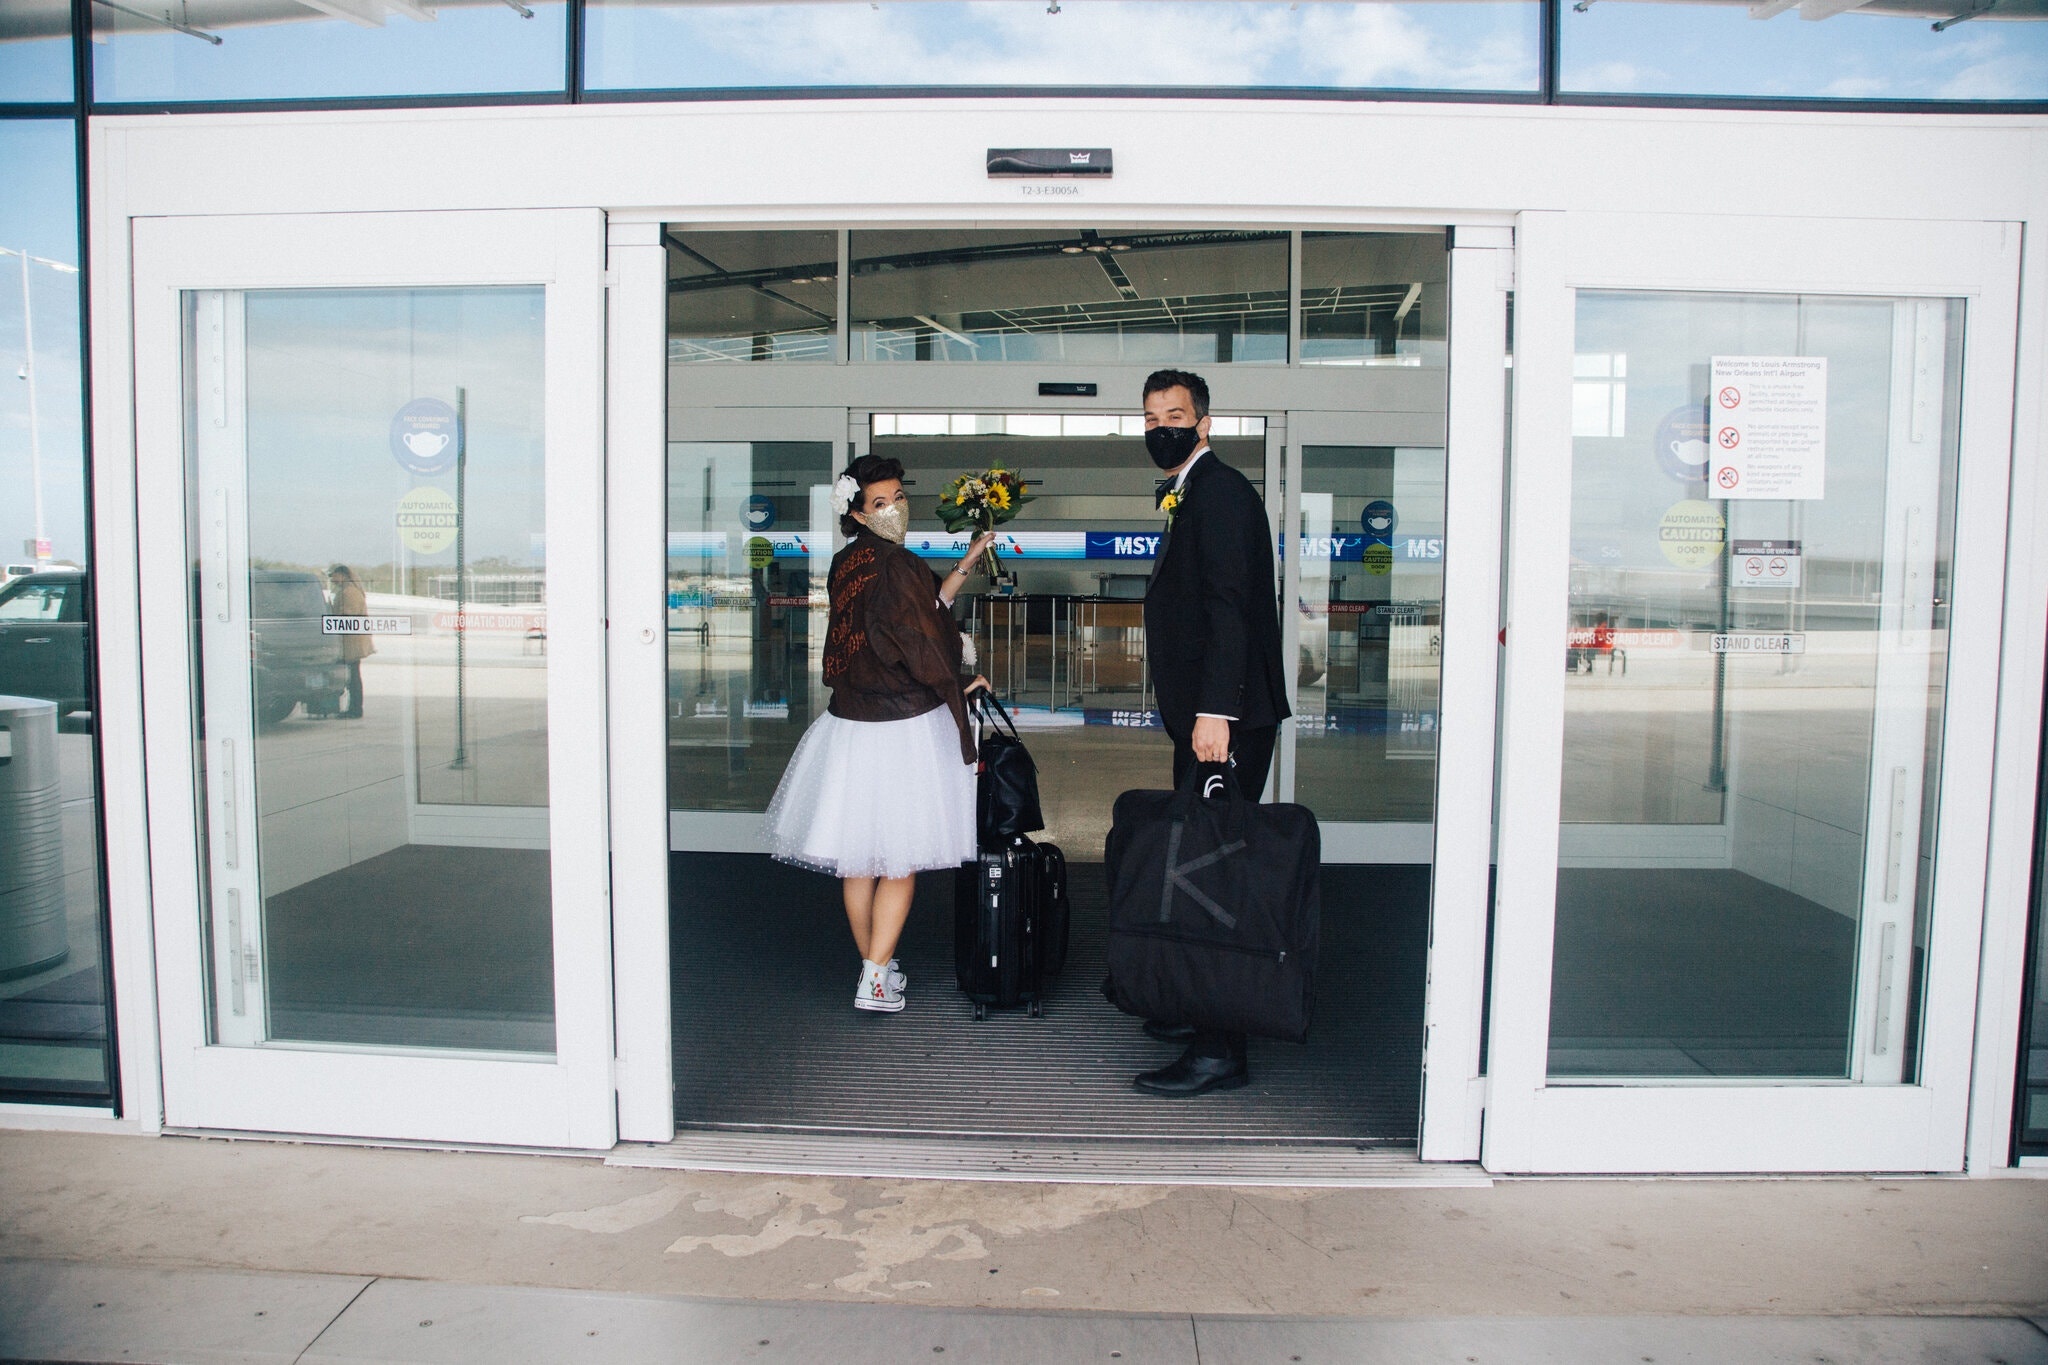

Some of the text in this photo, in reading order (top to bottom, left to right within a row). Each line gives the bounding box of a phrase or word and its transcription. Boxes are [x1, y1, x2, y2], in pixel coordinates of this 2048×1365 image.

[1021, 186, 1079, 195] T2-3-E3005A
[1716, 360, 1749, 368] Welcome
[1752, 360, 1760, 368] to
[1782, 362, 1821, 370] Armstrong
[1715, 369, 1732, 377] New
[1780, 370, 1806, 378] Airport
[401, 502, 454, 510] AUTOMATIC
[398, 515, 456, 526] CAUTION
[1664, 516, 1720, 524] AUTOMATIC
[414, 532, 441, 540] DOOR
[1662, 528, 1722, 541] CAUTION
[1114, 536, 1160, 555] MSY
[1300, 538, 1346, 557] MSY
[1408, 539, 1444, 558] MS
[1677, 546, 1706, 554] DOOR
[770, 598, 798, 606] AUTOMATIC
[326, 619, 360, 632] STAND
[364, 620, 397, 632] CLEAR
[440, 616, 496, 628] AUTOMATIC
[498, 616, 524, 628] DOOR
[1569, 632, 1596, 645] DOOR
[1606, 632, 1639, 645] STAND
[1641, 632, 1673, 645] CLEAR
[1714, 637, 1750, 650] STAND
[1754, 638, 1790, 650] CLEAR
[1160, 820, 1247, 929] K
